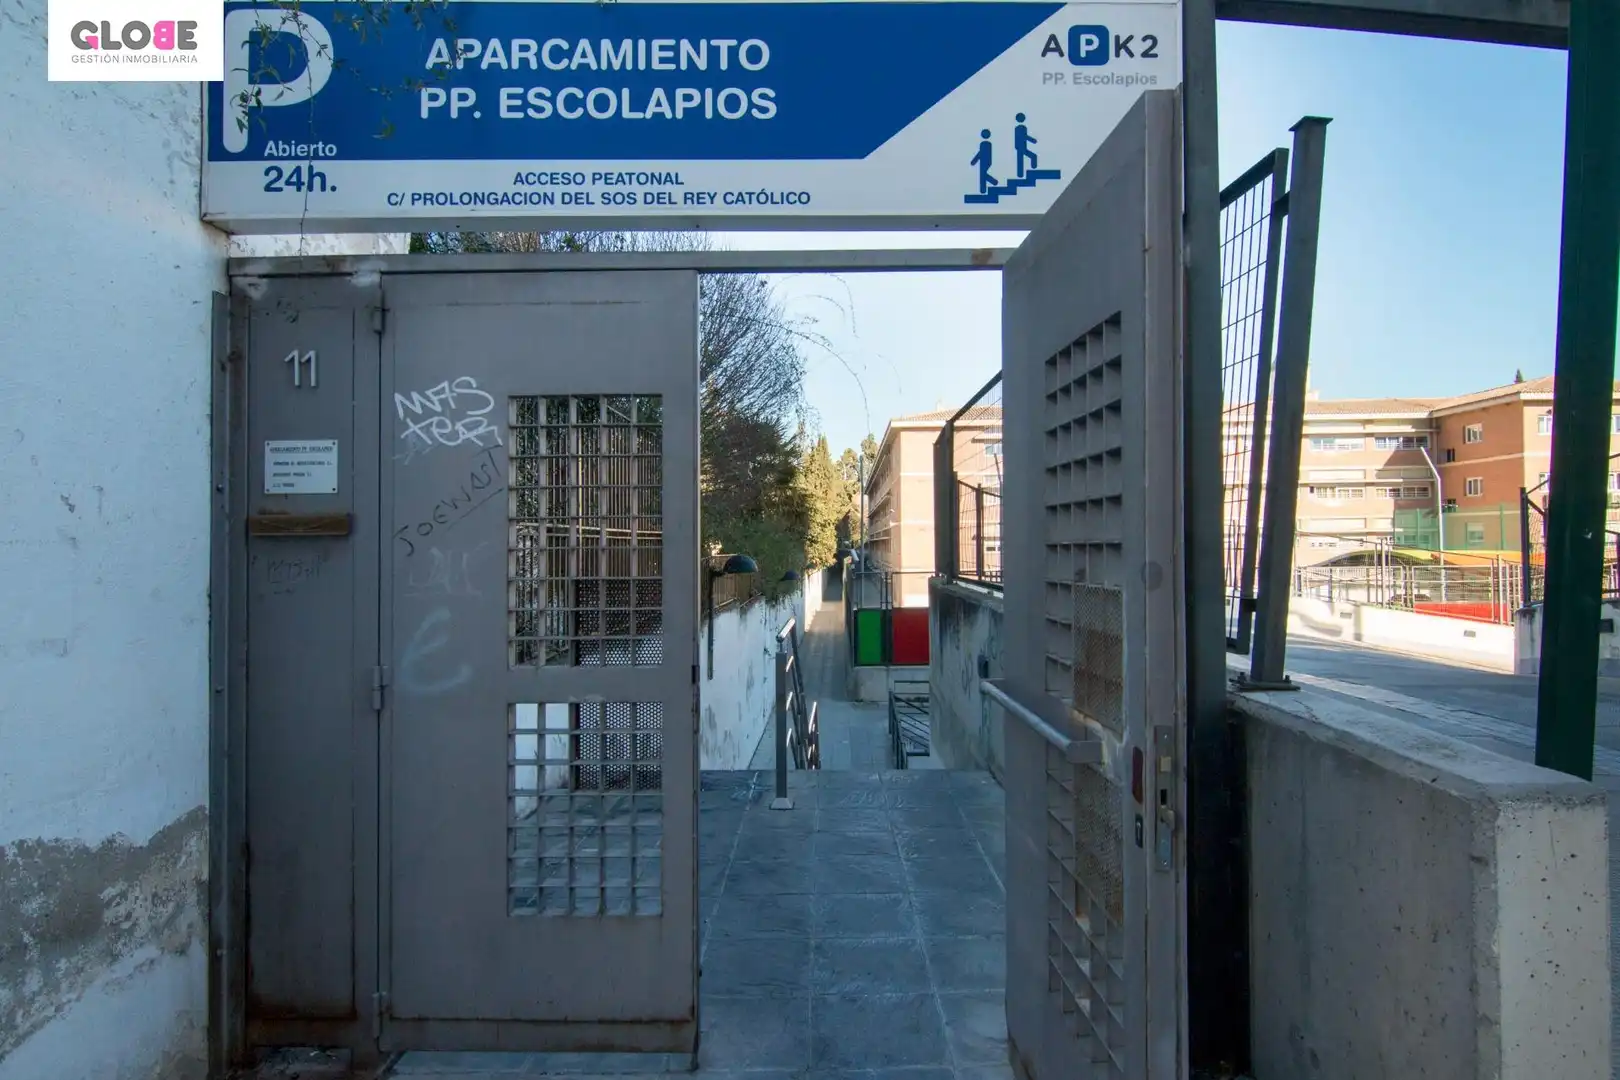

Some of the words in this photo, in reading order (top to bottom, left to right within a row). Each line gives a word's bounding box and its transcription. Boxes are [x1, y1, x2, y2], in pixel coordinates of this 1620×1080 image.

[425, 38, 770, 71] APARCAMIENTO
[223, 8, 334, 154] P
[1042, 72, 1067, 85] PP.
[1073, 71, 1158, 87] Escolapios
[420, 87, 481, 120] PP.
[499, 86, 778, 120] ESCOLAPIOS
[264, 140, 338, 158] Abierto
[263, 165, 338, 193] 24h.
[513, 171, 586, 187] ACCESO
[591, 172, 685, 187] PEATONAL
[387, 191, 404, 207] C/
[411, 191, 556, 207] PROLONGACION
[561, 191, 596, 206] DEL
[600, 190, 639, 206] SOS
[643, 191, 679, 206] DEL
[683, 191, 718, 206] REY
[722, 188, 811, 206] CATÓLICO
[284, 349, 317, 387] 11
